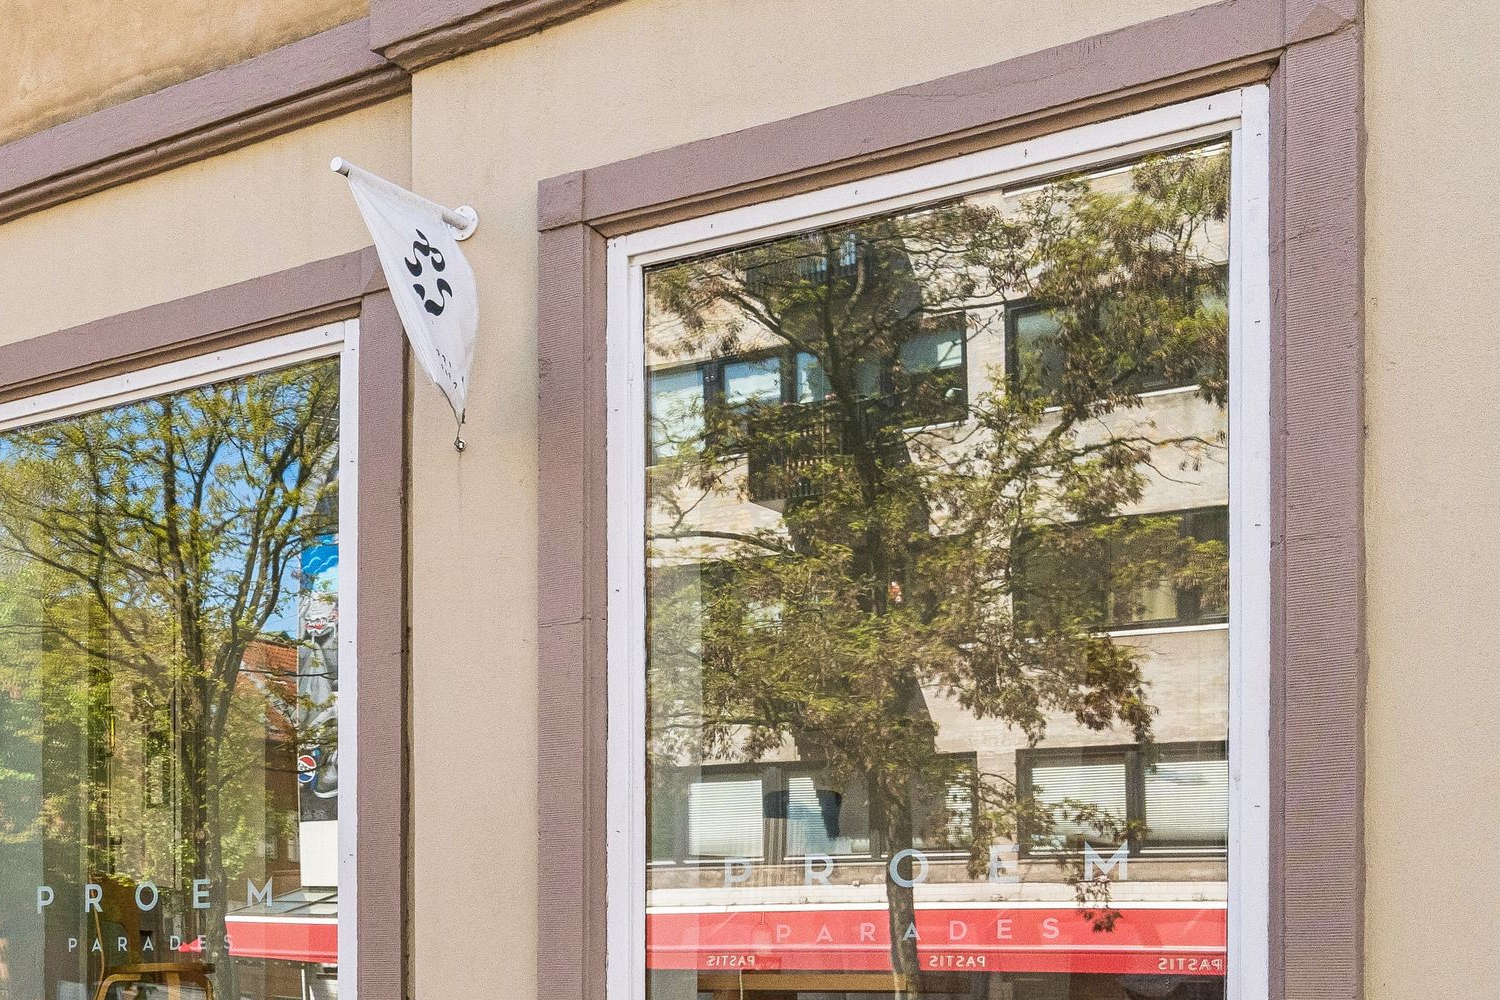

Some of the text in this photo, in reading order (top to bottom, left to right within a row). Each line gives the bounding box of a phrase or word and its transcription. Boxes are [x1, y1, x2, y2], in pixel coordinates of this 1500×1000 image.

[723, 841, 1129, 890] PROEM
[36, 876, 274, 914] PROEM
[68, 934, 236, 953] PARADES
[775, 917, 1060, 943] PARADES
